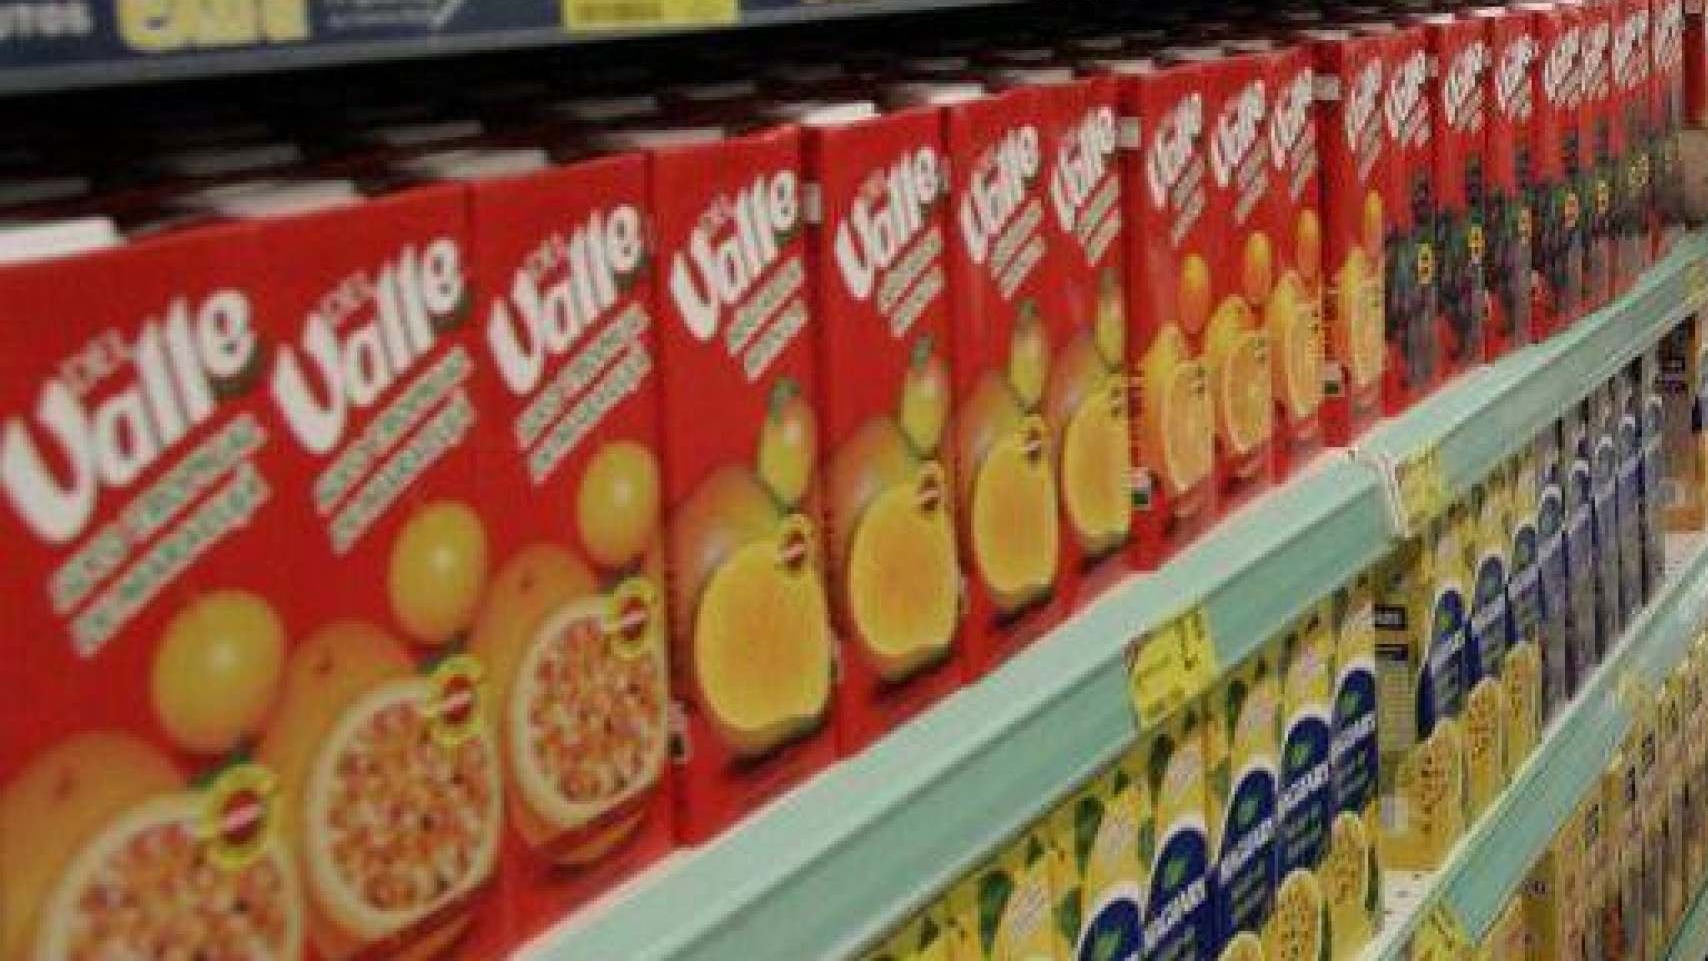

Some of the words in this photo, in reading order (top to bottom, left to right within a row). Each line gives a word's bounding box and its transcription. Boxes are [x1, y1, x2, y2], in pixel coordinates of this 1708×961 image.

[271, 236, 466, 456] Valle
[487, 205, 646, 396] Valle
[669, 169, 798, 340] Valle
[0, 288, 258, 544] Valle
